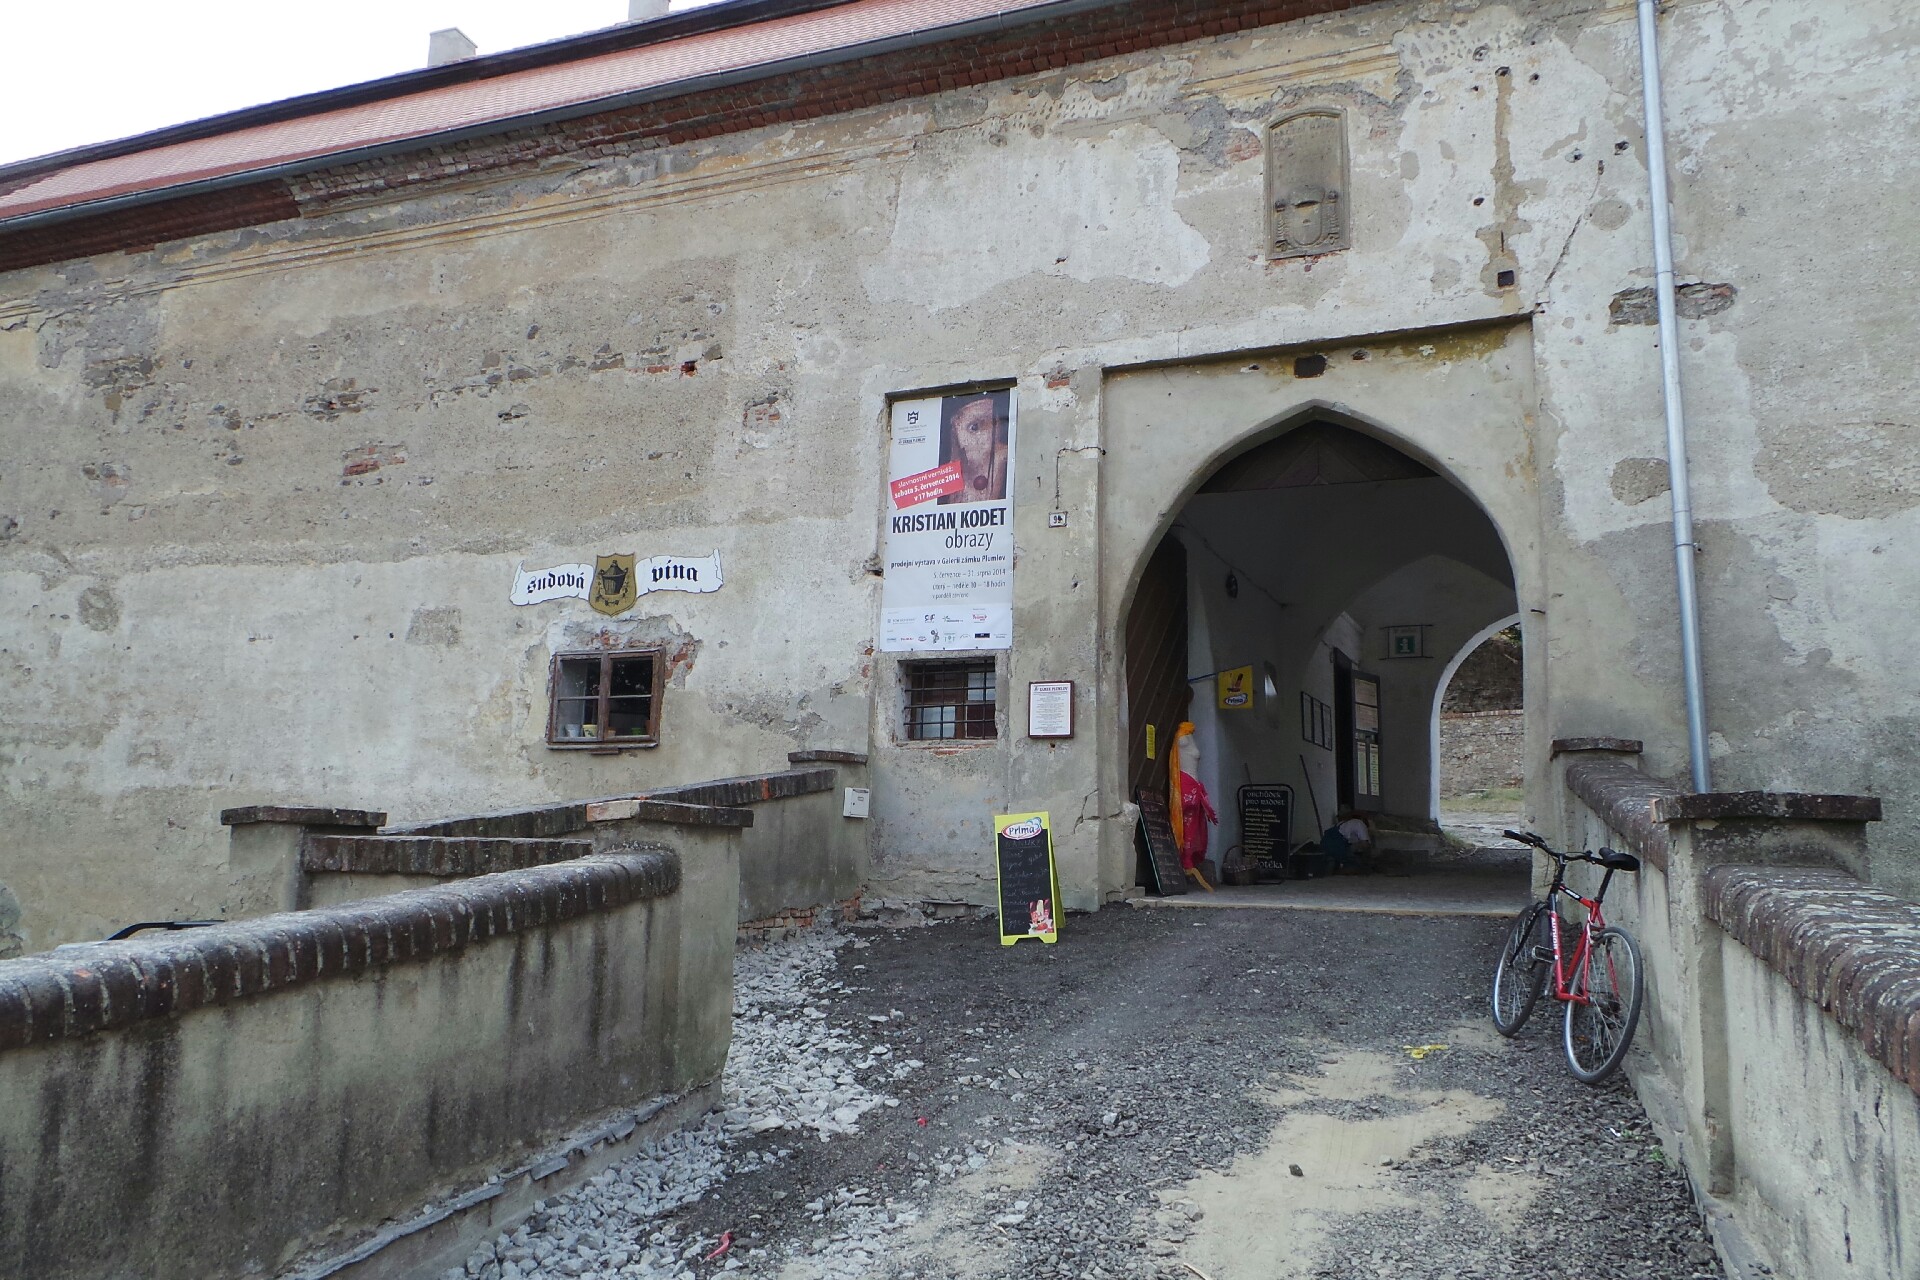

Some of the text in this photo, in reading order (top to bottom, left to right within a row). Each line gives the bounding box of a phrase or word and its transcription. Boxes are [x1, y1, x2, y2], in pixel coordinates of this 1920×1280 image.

[894, 487, 914, 499] sobota
[920, 478, 945, 490] července
[945, 472, 960, 483] 2014
[919, 492, 926, 501] 17
[926, 488, 943, 499] hodin
[892, 507, 1007, 534] KRISTIAN KODET
[945, 528, 994, 551] obrazy
[890, 560, 914, 569] prodejní
[914, 558, 936, 567] výstava
[941, 557, 960, 565] Galerii
[961, 556, 981, 564] zámku
[981, 554, 1006, 563] Plumlov
[526, 559, 699, 594] sudová vína
[992, 568, 1006, 576] 2014
[1008, 824, 1036, 837] Prima
